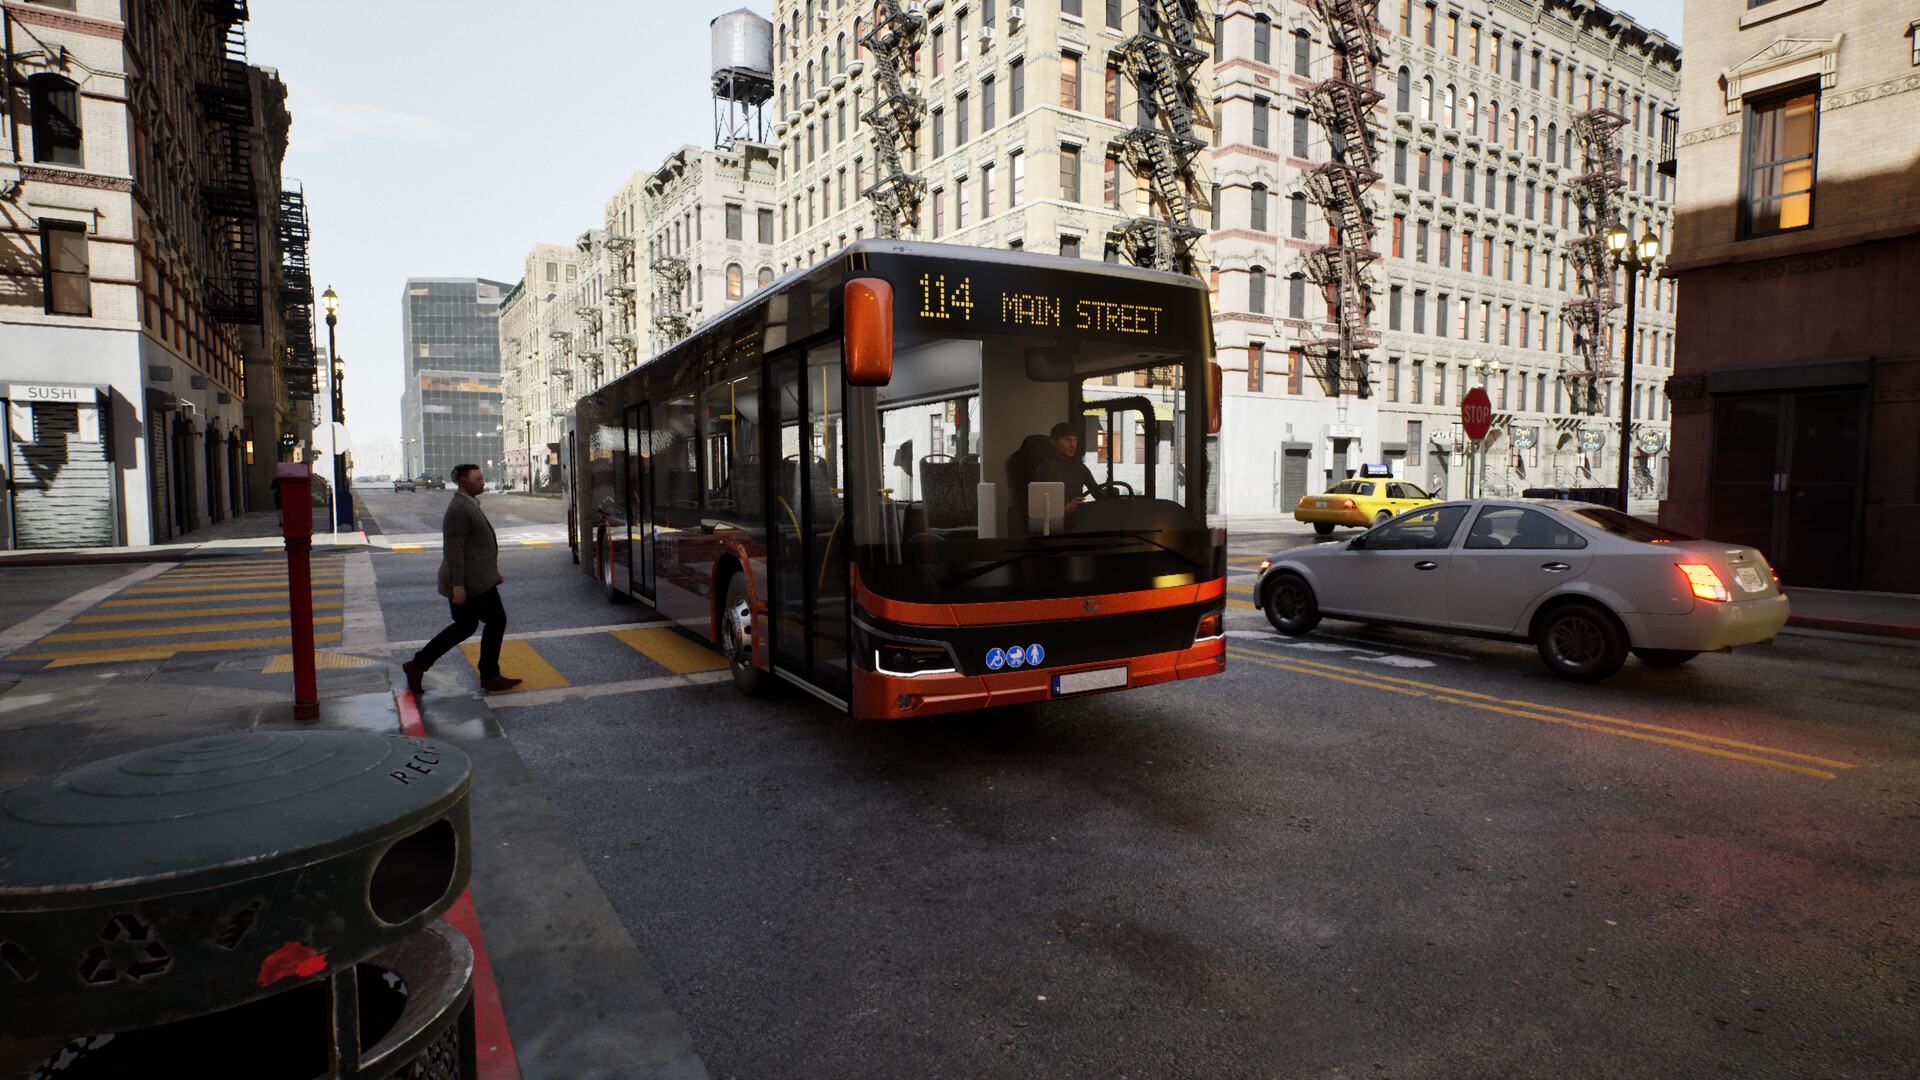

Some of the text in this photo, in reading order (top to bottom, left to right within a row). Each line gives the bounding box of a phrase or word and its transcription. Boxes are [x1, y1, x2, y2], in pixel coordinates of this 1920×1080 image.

[920, 273, 1163, 334] 114 MAIN STREET
[28, 387, 77, 399] SUSHI
[1464, 405, 1489, 423] STOP
[1516, 428, 1531, 436] Deli
[1584, 431, 1599, 439] Deli
[1514, 438, 1532, 447] Cafe
